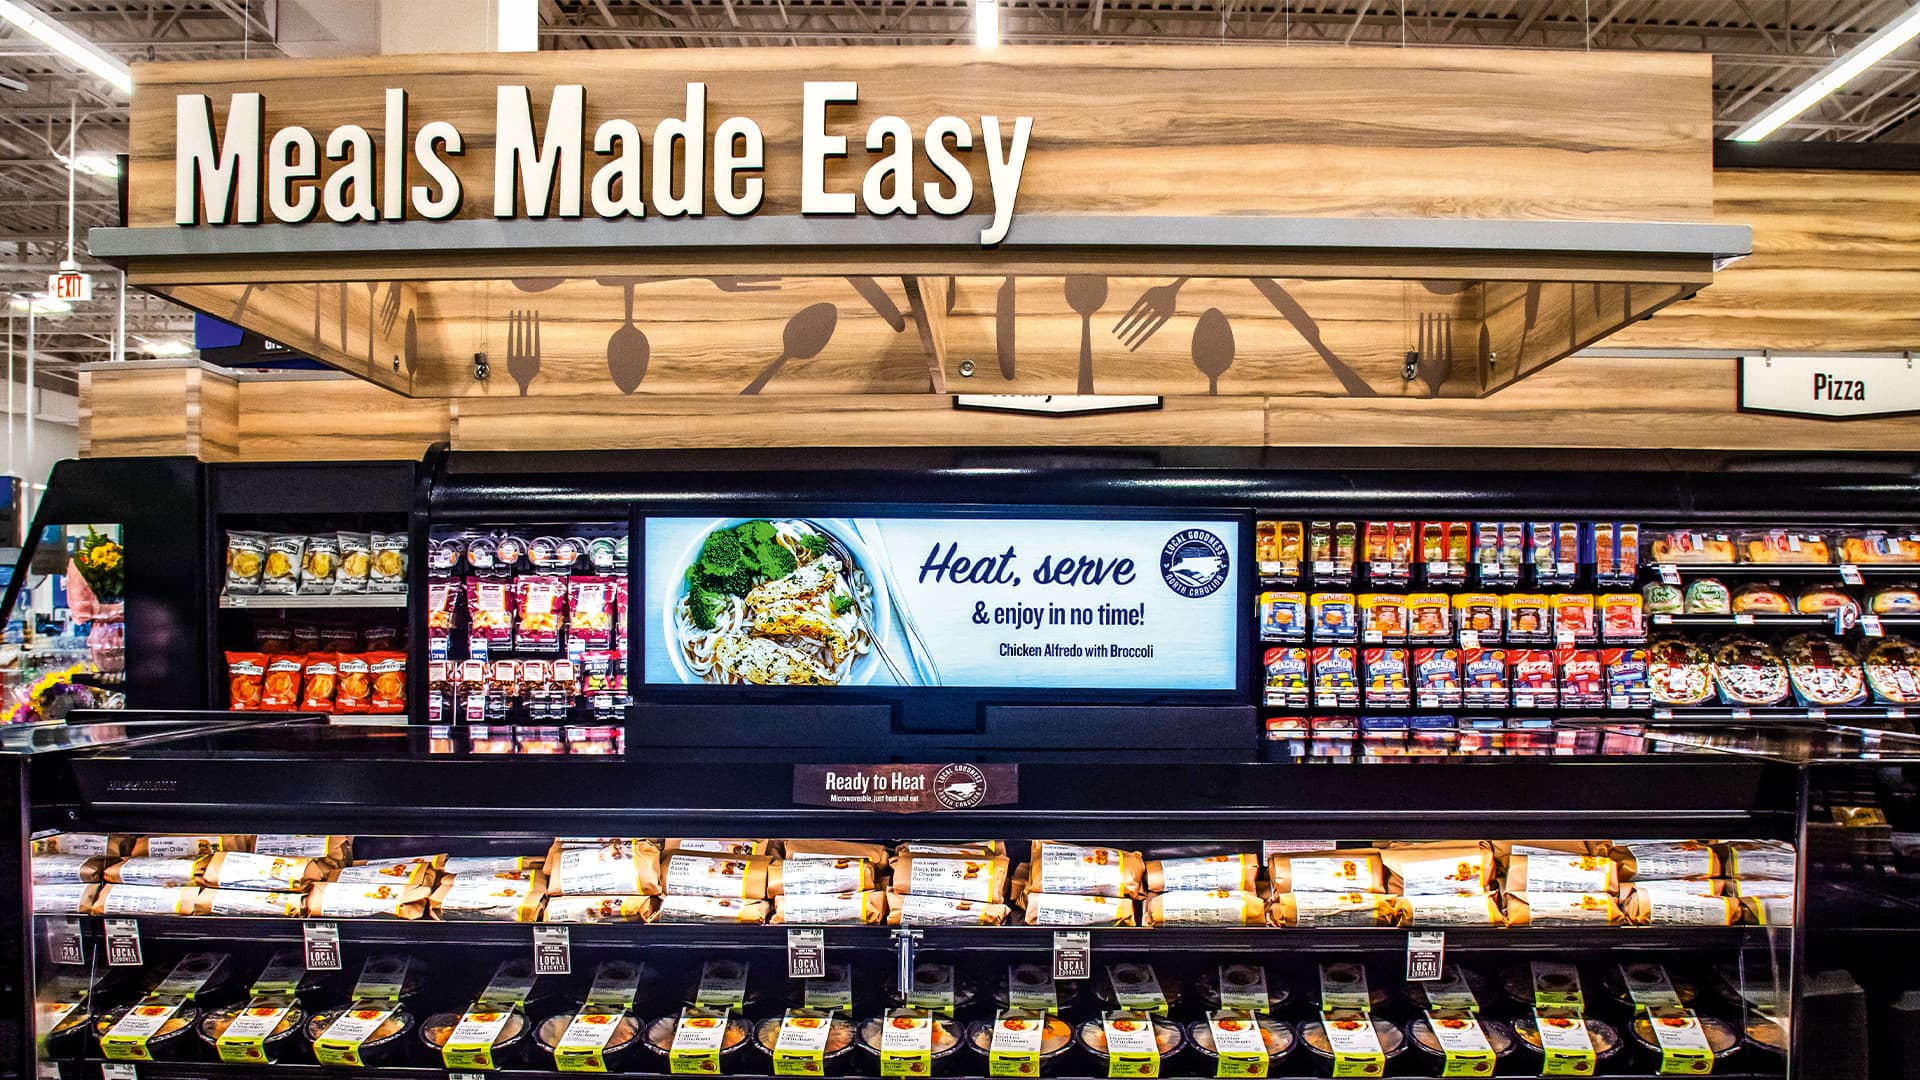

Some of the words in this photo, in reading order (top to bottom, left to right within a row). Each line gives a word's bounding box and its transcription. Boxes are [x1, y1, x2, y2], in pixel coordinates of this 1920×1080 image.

[175, 88, 464, 225] Meals
[493, 82, 765, 218] Made
[801, 81, 1034, 248] Easy
[57, 275, 82, 298] EXIT
[1813, 373, 1866, 401] Pizza
[1164, 533, 1187, 555] LOCAL
[1187, 530, 1226, 556] GOODNESS
[918, 541, 1022, 588] Heat,
[1033, 554, 1137, 588] serve
[1165, 573, 1188, 595] NORTH
[1188, 574, 1225, 597] CAROLINA
[971, 600, 990, 626] &
[994, 602, 1046, 630] enjoy
[1048, 602, 1066, 626] in
[1070, 606, 1094, 627] no
[1097, 602, 1146, 627] time!
[999, 642, 1043, 659] Chicken
[1044, 643, 1083, 659] Alfredo
[1084, 643, 1109, 659] with
[1110, 643, 1155, 660] Broccoli
[825, 771, 872, 794] Ready
[874, 773, 887, 791] to
[891, 772, 925, 791] Heat
[938, 768, 954, 785] LOCAL
[953, 764, 983, 785] GOODNESS
[886, 794, 898, 802] heat
[898, 794, 908, 802] and
[111, 947, 137, 957] LOCAL
[310, 951, 336, 961] LOCAL
[539, 955, 565, 966] LOCAL
[793, 958, 819, 969] LOCAL
[1058, 960, 1084, 970] LOCAL
[1412, 961, 1437, 971] LOCAL
